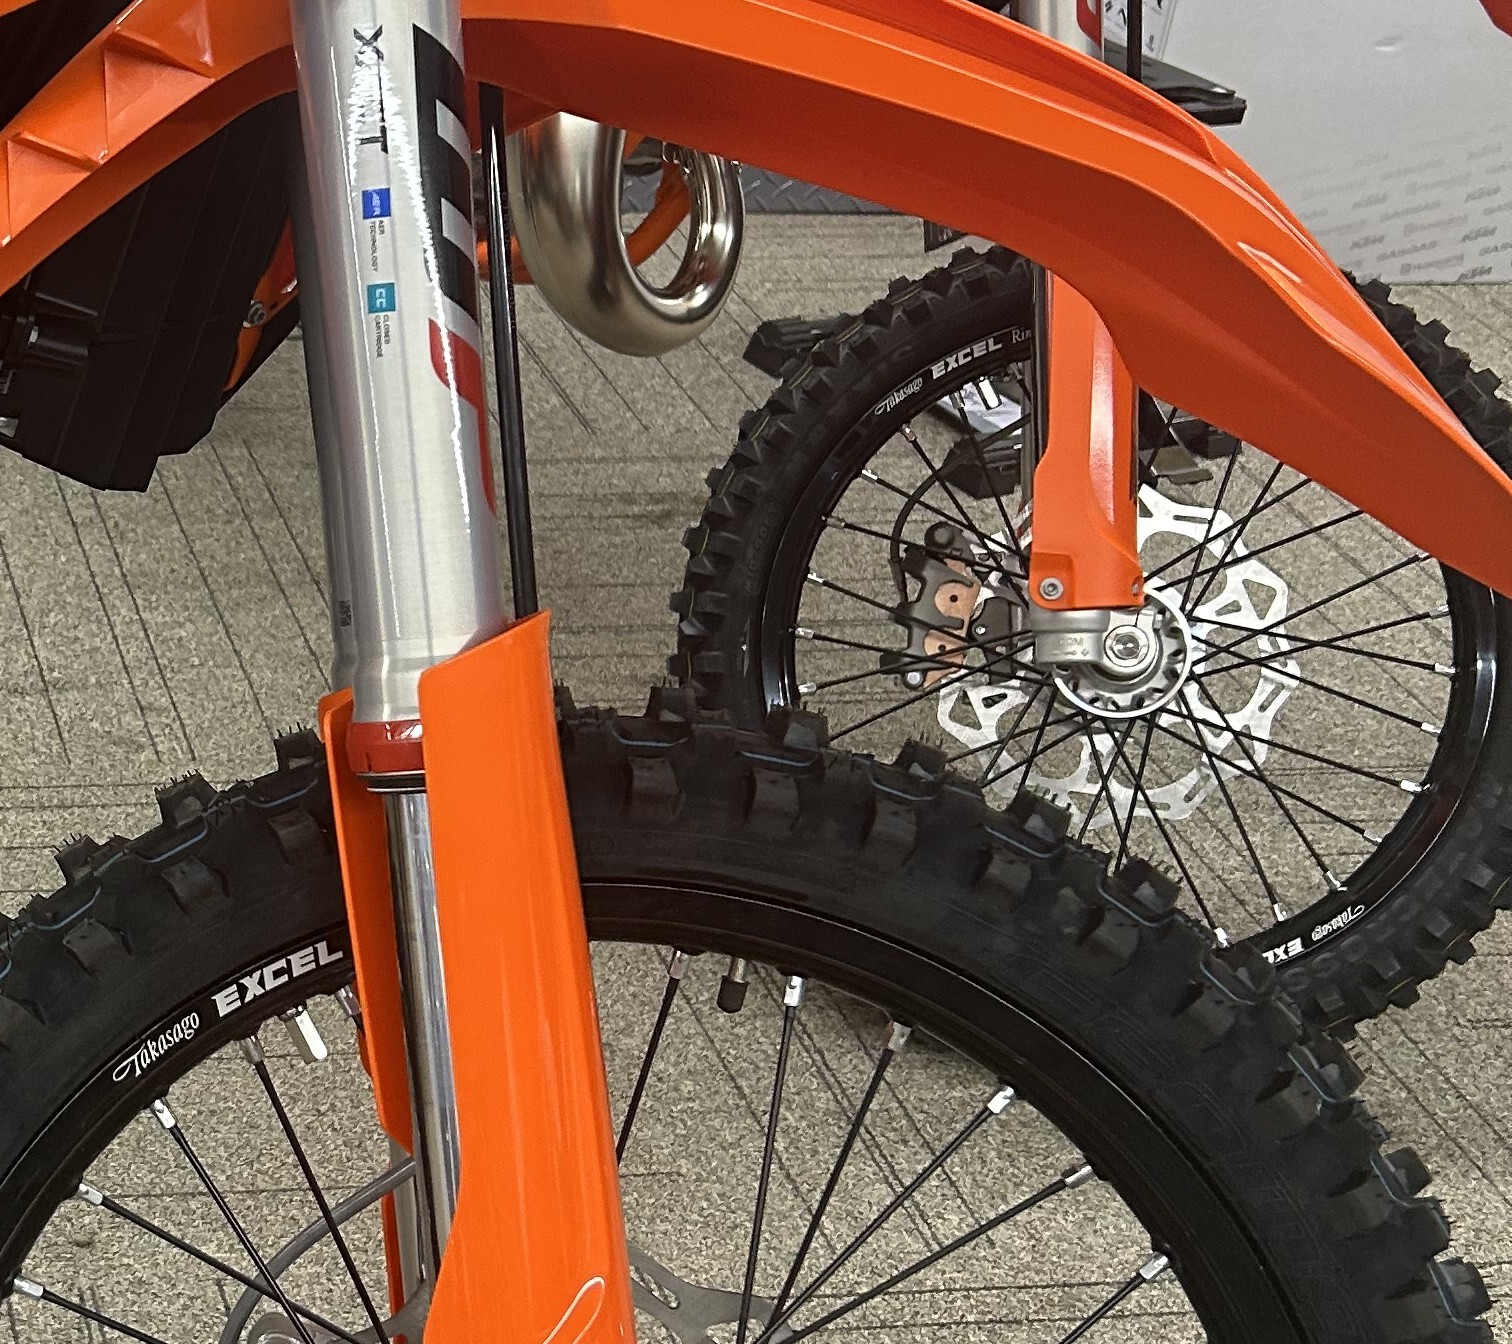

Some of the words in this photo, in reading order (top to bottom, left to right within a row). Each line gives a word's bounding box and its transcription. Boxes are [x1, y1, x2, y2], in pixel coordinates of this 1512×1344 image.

[352, 24, 389, 154] XT
[369, 220, 379, 273] TECHNOLOGY
[377, 219, 386, 236] AER
[375, 288, 387, 309] CC
[374, 315, 384, 358] CARTRIDGE
[382, 314, 391, 345] CLOSED
[874, 377, 923, 416] Takasago
[931, 336, 1003, 381] EXCEL
[112, 1012, 200, 1082] Takasago
[210, 940, 344, 1018] EXCEL
